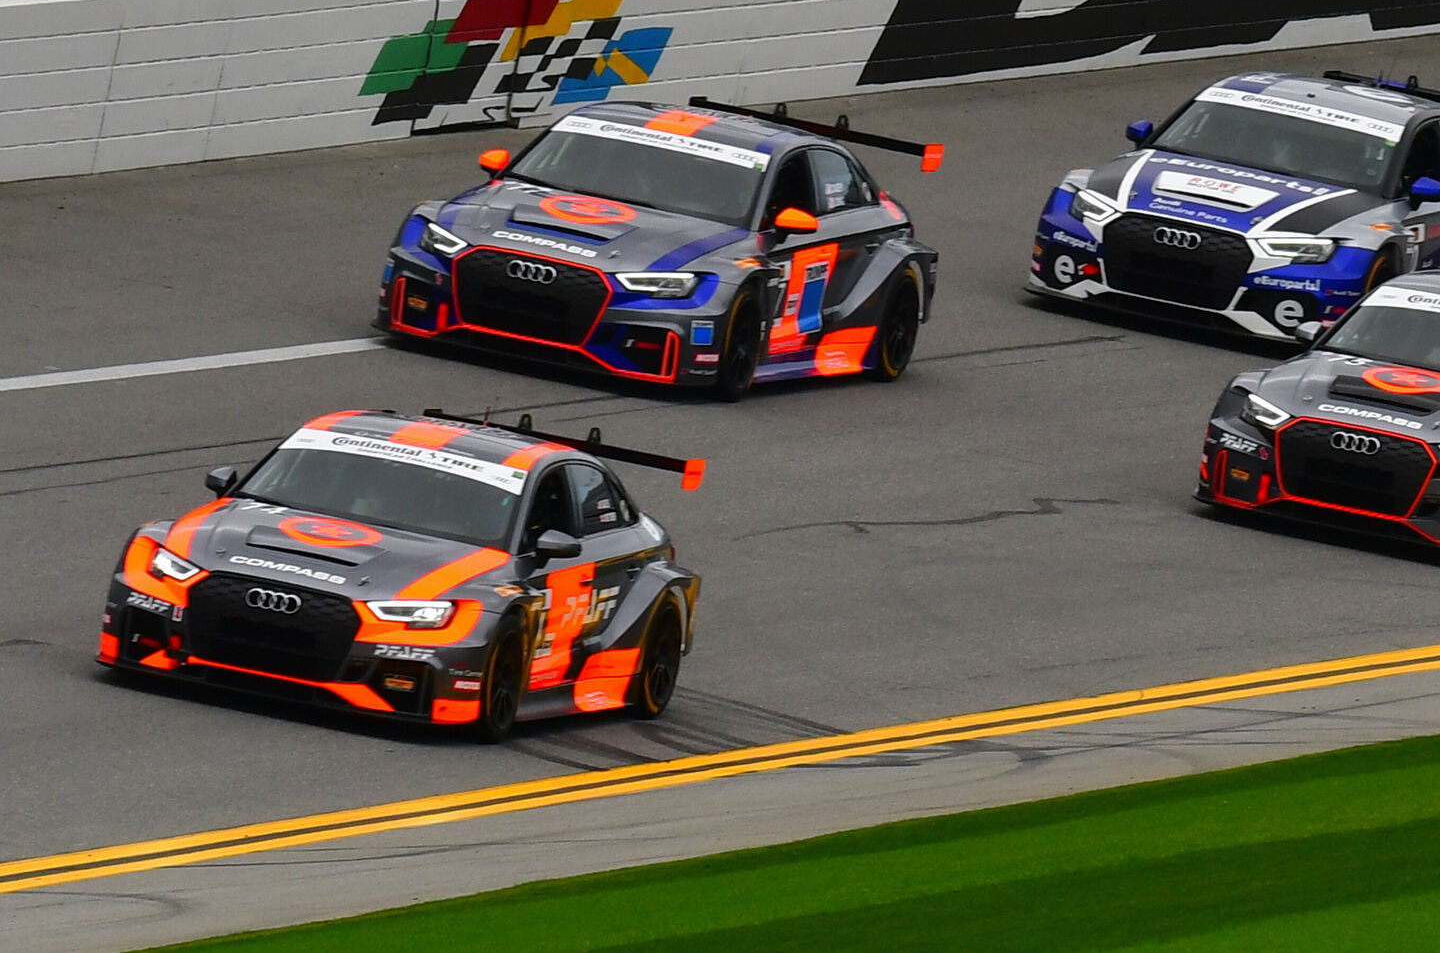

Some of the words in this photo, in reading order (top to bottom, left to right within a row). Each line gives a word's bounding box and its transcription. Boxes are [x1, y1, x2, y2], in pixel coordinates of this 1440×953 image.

[1240, 94, 1311, 113] Continental
[599, 123, 673, 143] Continental
[1188, 177, 1240, 192] ROWE
[1153, 197, 1182, 208] Audi
[1149, 203, 1196, 217] Genuine
[1196, 210, 1229, 224] Parts
[492, 230, 599, 259] COMPASS
[1274, 299, 1304, 328] e
[1317, 404, 1424, 430] COMPASS
[1219, 433, 1258, 453] PFAFF
[331, 436, 422, 459] Continental
[441, 456, 485, 473] TIRE
[229, 555, 348, 585] COMPASS
[126, 591, 172, 613] PFAFF
[560, 586, 621, 629] PFAFF
[374, 644, 437, 660] PFAFF
